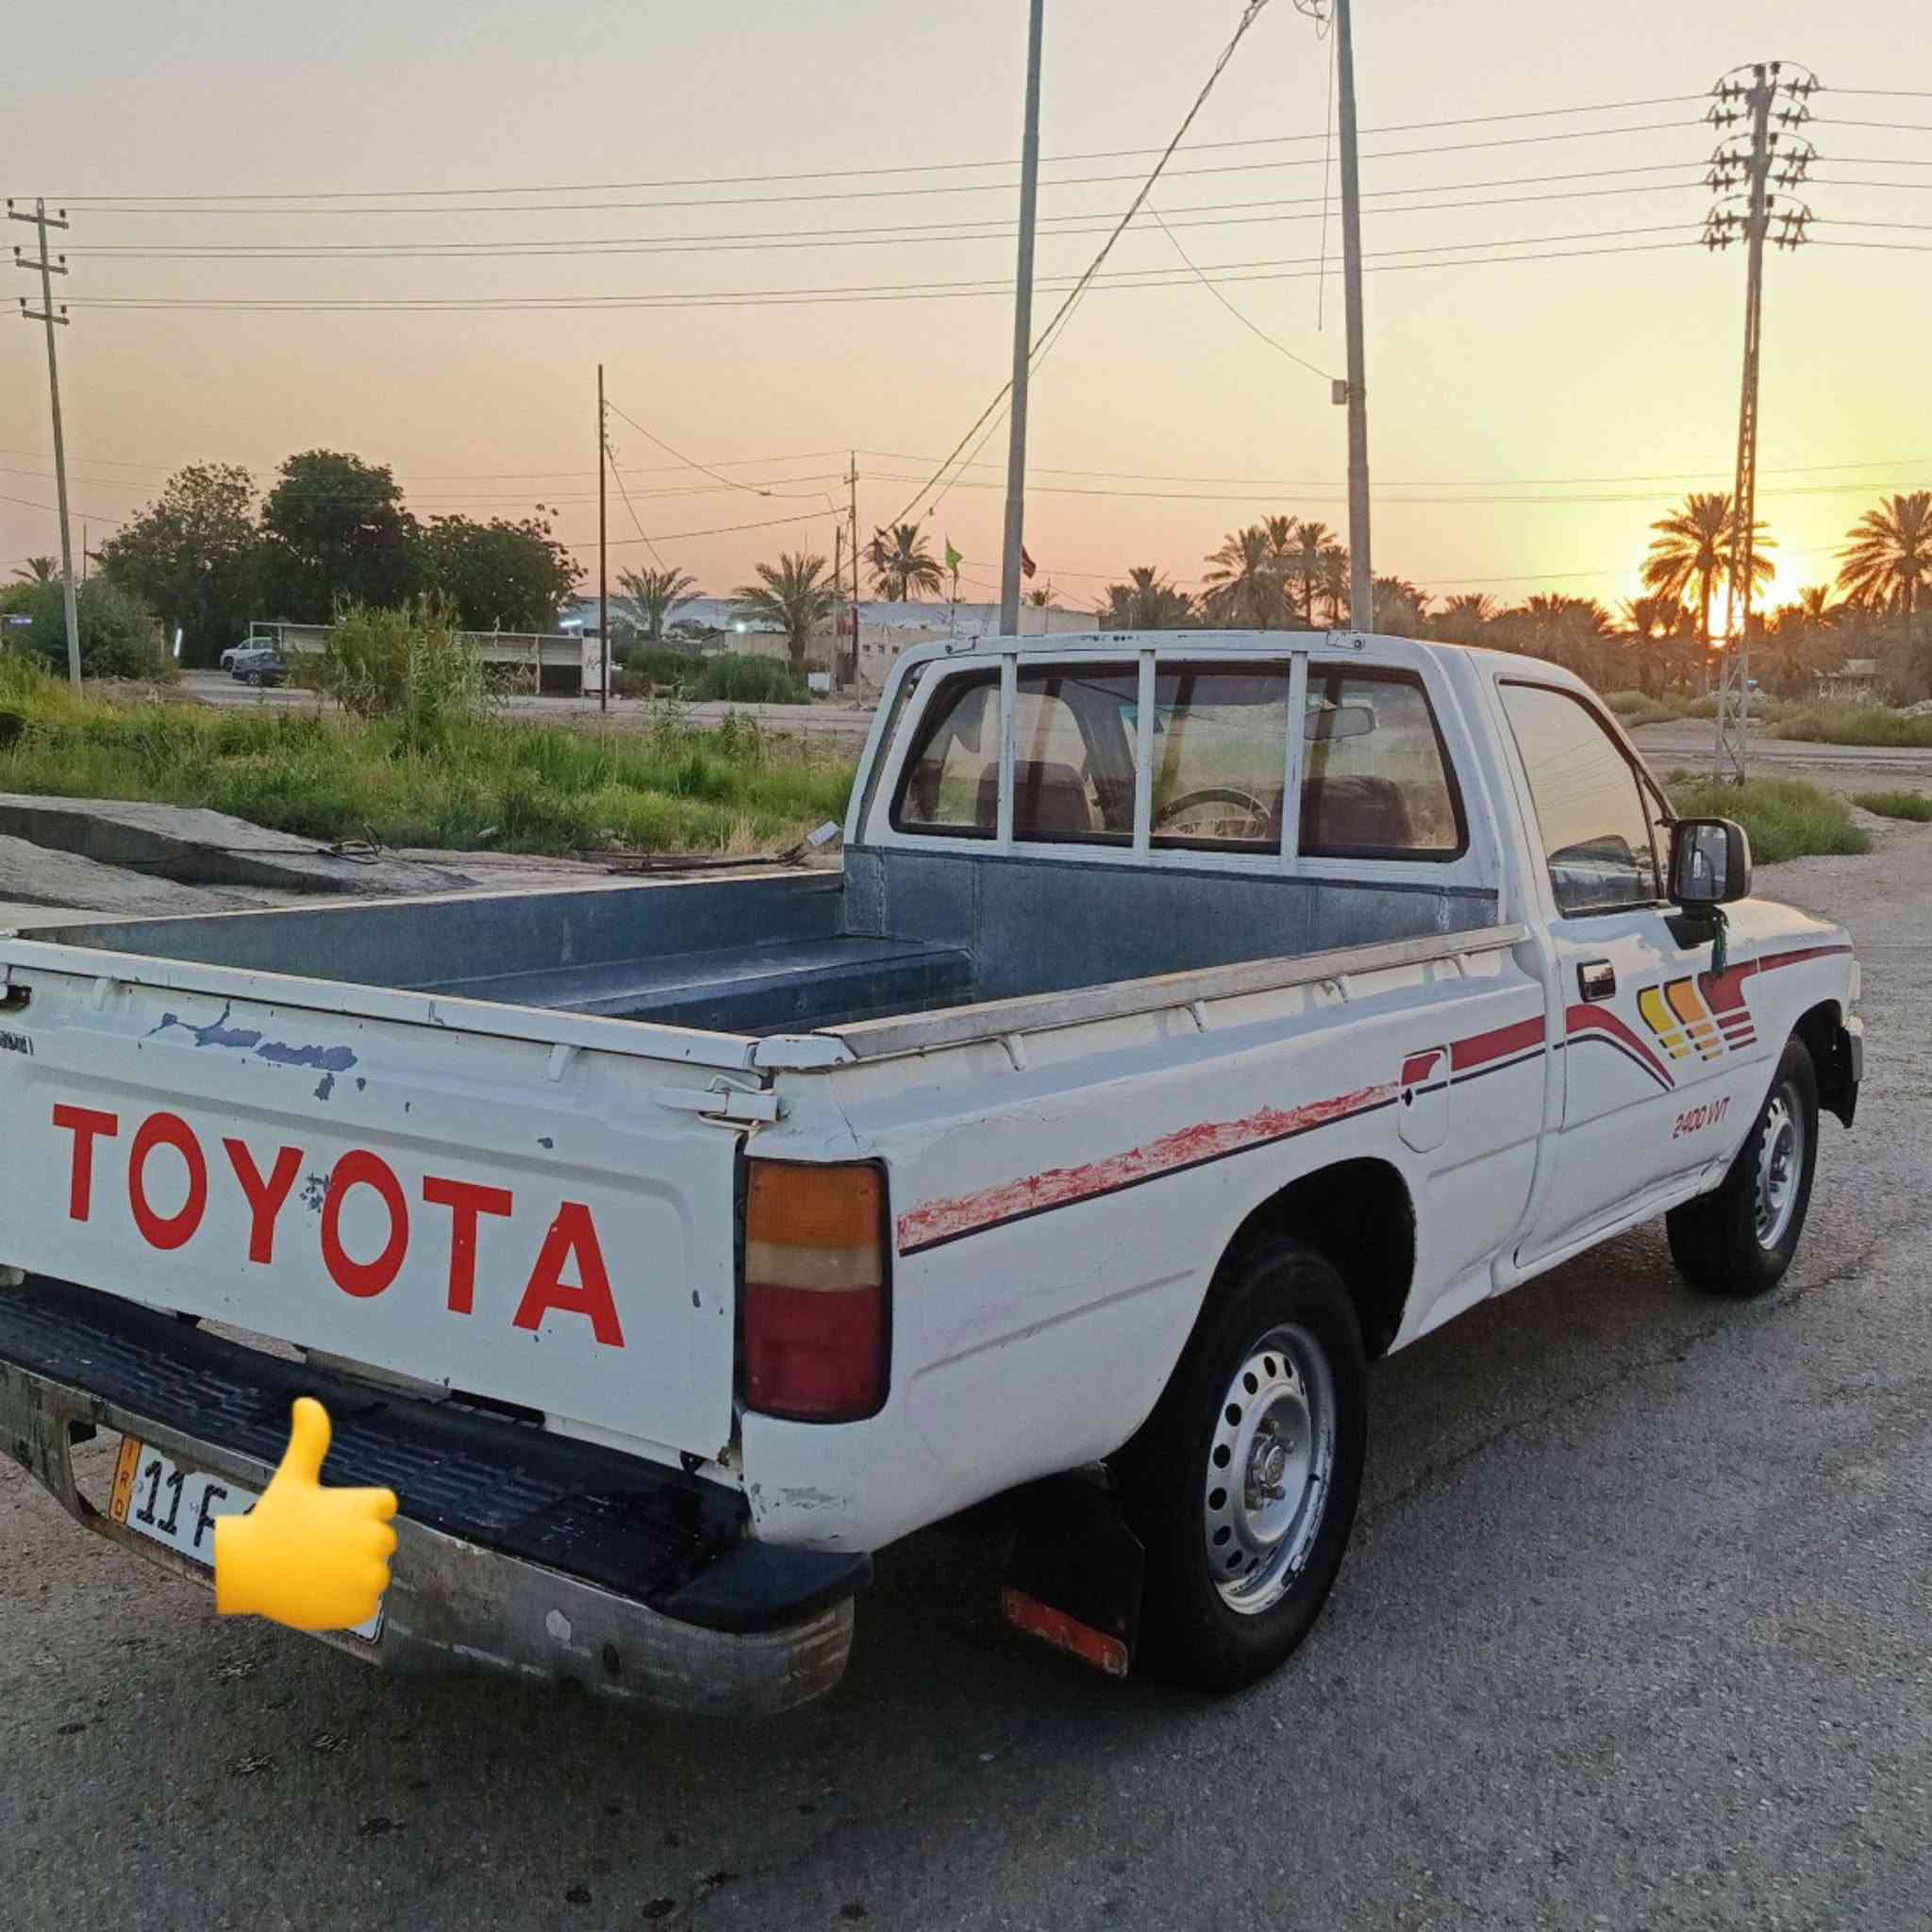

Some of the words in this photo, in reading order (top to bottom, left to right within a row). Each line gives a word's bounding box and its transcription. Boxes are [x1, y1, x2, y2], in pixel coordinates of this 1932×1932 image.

[1673, 1105, 1707, 1140] 2400
[53, 1103, 625, 1347] TOYOTA
[136, 1460, 186, 1535] 11
